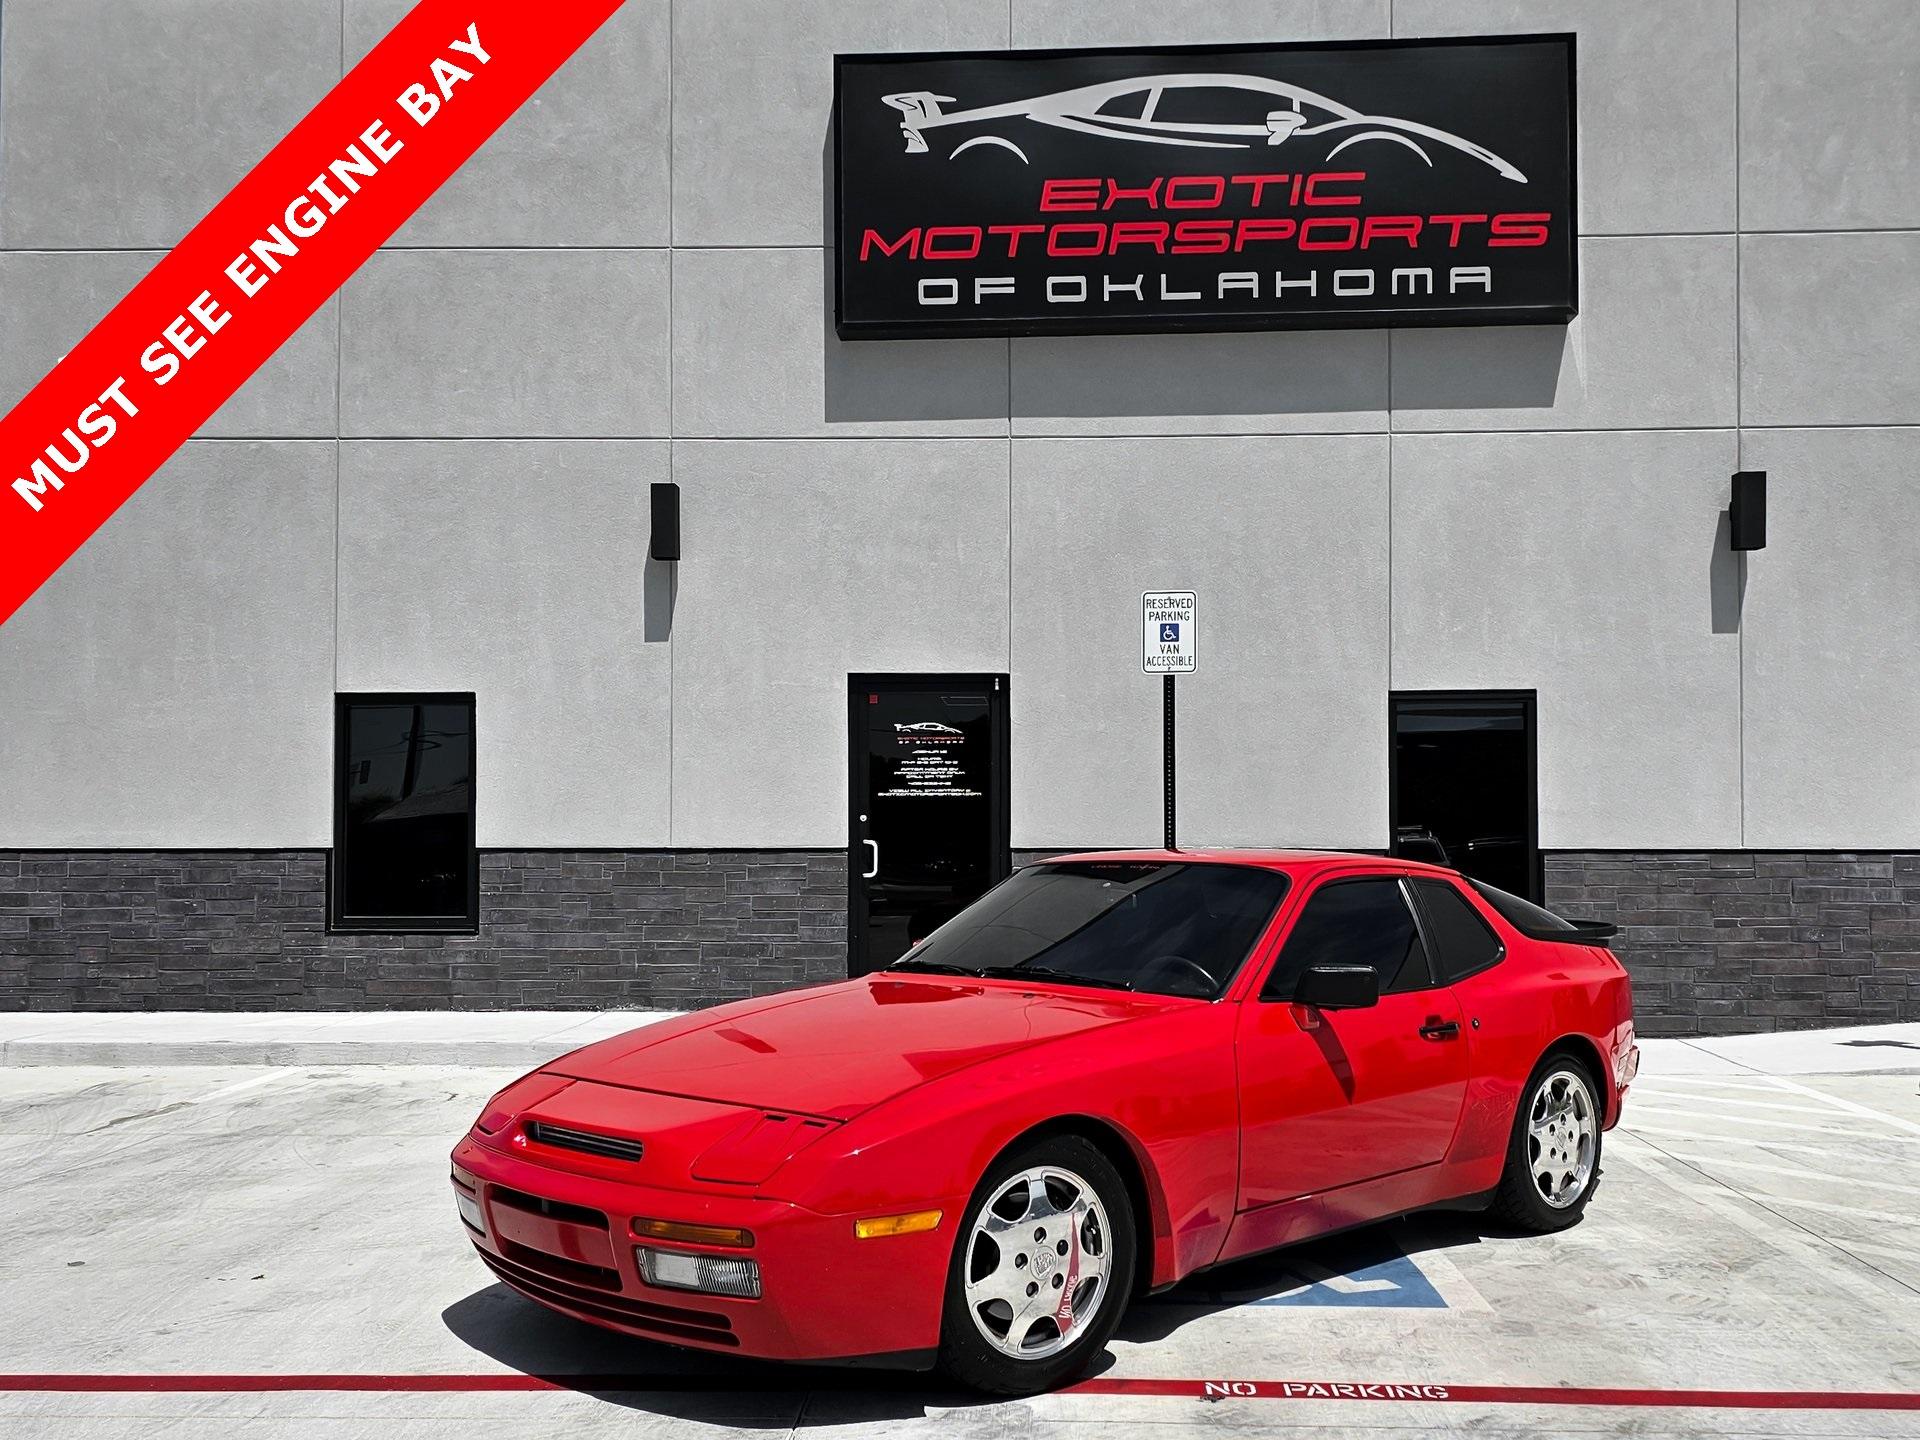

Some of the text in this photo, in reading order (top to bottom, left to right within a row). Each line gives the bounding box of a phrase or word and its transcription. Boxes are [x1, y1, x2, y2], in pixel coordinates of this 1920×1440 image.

[1039, 171, 1366, 212] EXOTIC
[859, 213, 1551, 261] MOTORSPORTS
[917, 266, 1492, 305] OF OKLAHOMA
[1146, 599, 1193, 609] RESERVED
[1149, 611, 1190, 621] PARKING
[1160, 644, 1179, 654] VAN
[1146, 656, 1192, 666] ACCESSIBLE
[1205, 1381, 1448, 1398] NO PARKING
